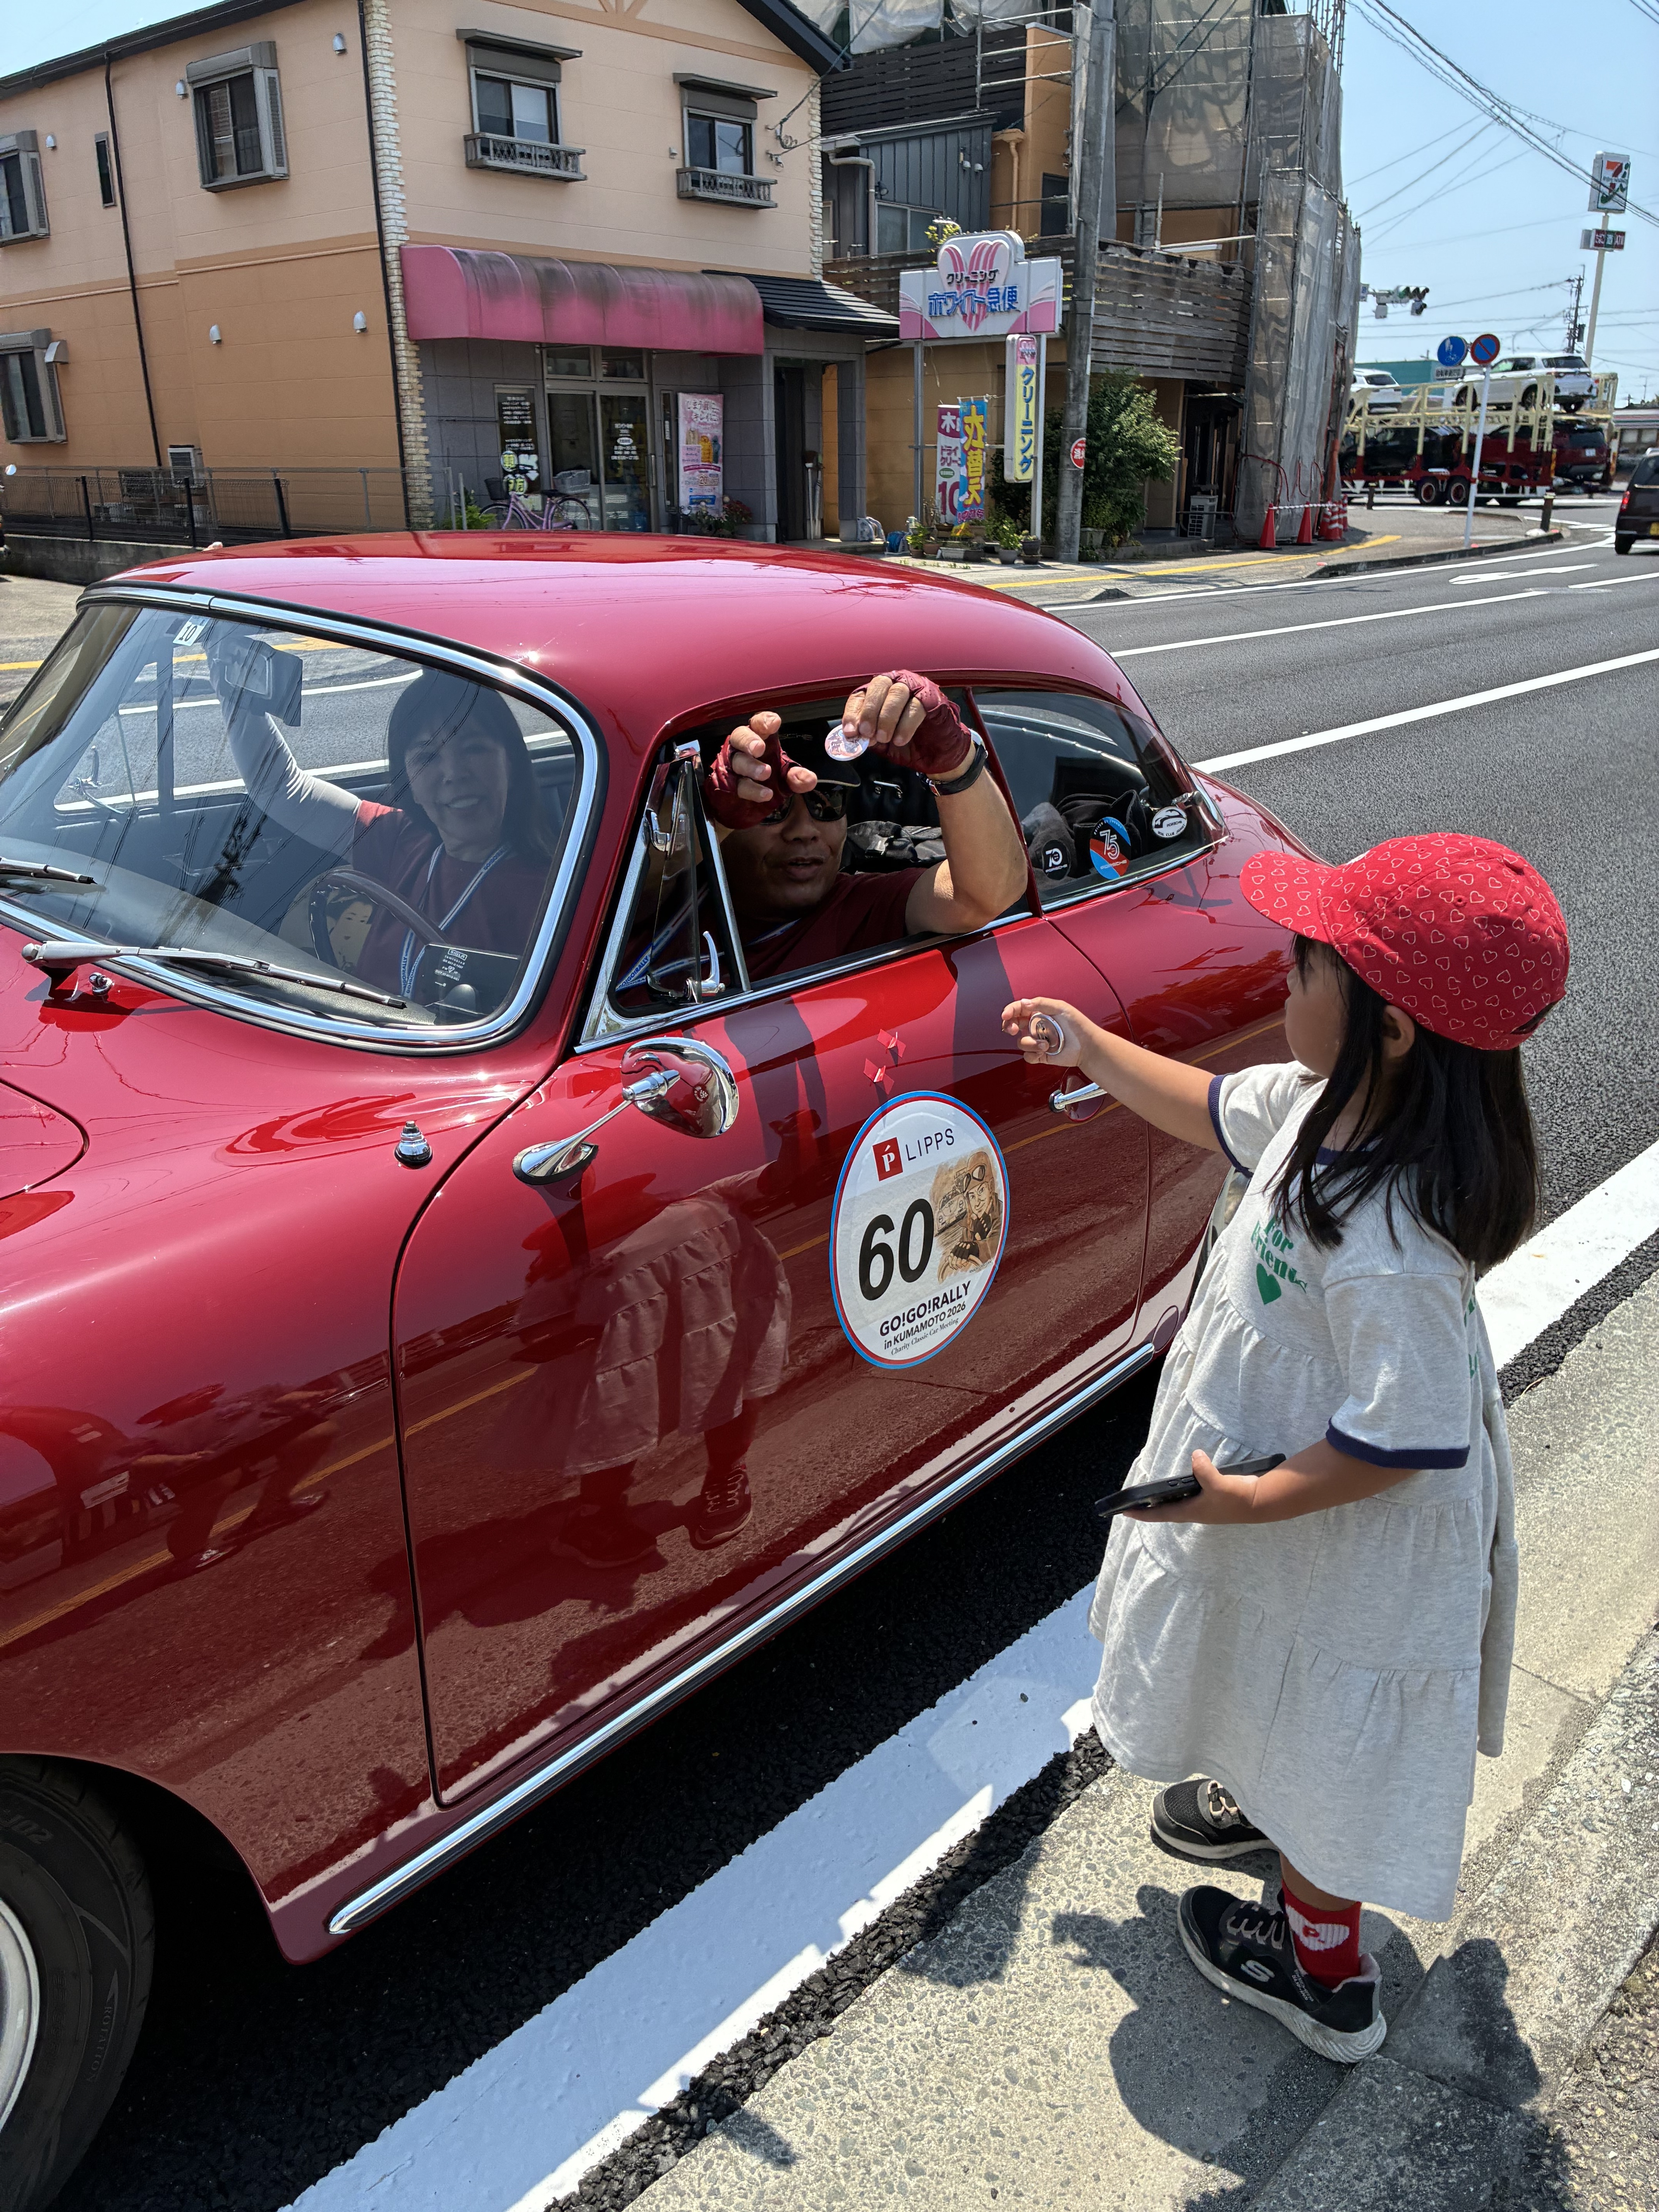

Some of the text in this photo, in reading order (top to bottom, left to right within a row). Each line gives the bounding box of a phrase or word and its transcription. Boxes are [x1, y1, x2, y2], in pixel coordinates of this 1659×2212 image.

[946, 268, 999, 285] クリーニング
[928, 285, 1021, 316] ホワイト急便
[1018, 366, 1035, 474] クリーニング
[178, 625, 198, 642] 10
[1046, 848, 1063, 867] 70
[1099, 829, 1120, 860] 75
[905, 1128, 955, 1161] LIPPS
[859, 1198, 934, 1301] 60
[880, 1280, 971, 1336] GO!GO!RALLY
[884, 1301, 966, 1350] in KUMAMOTO 2026
[891, 1317, 959, 1355] Charity Classic Car Meeting
